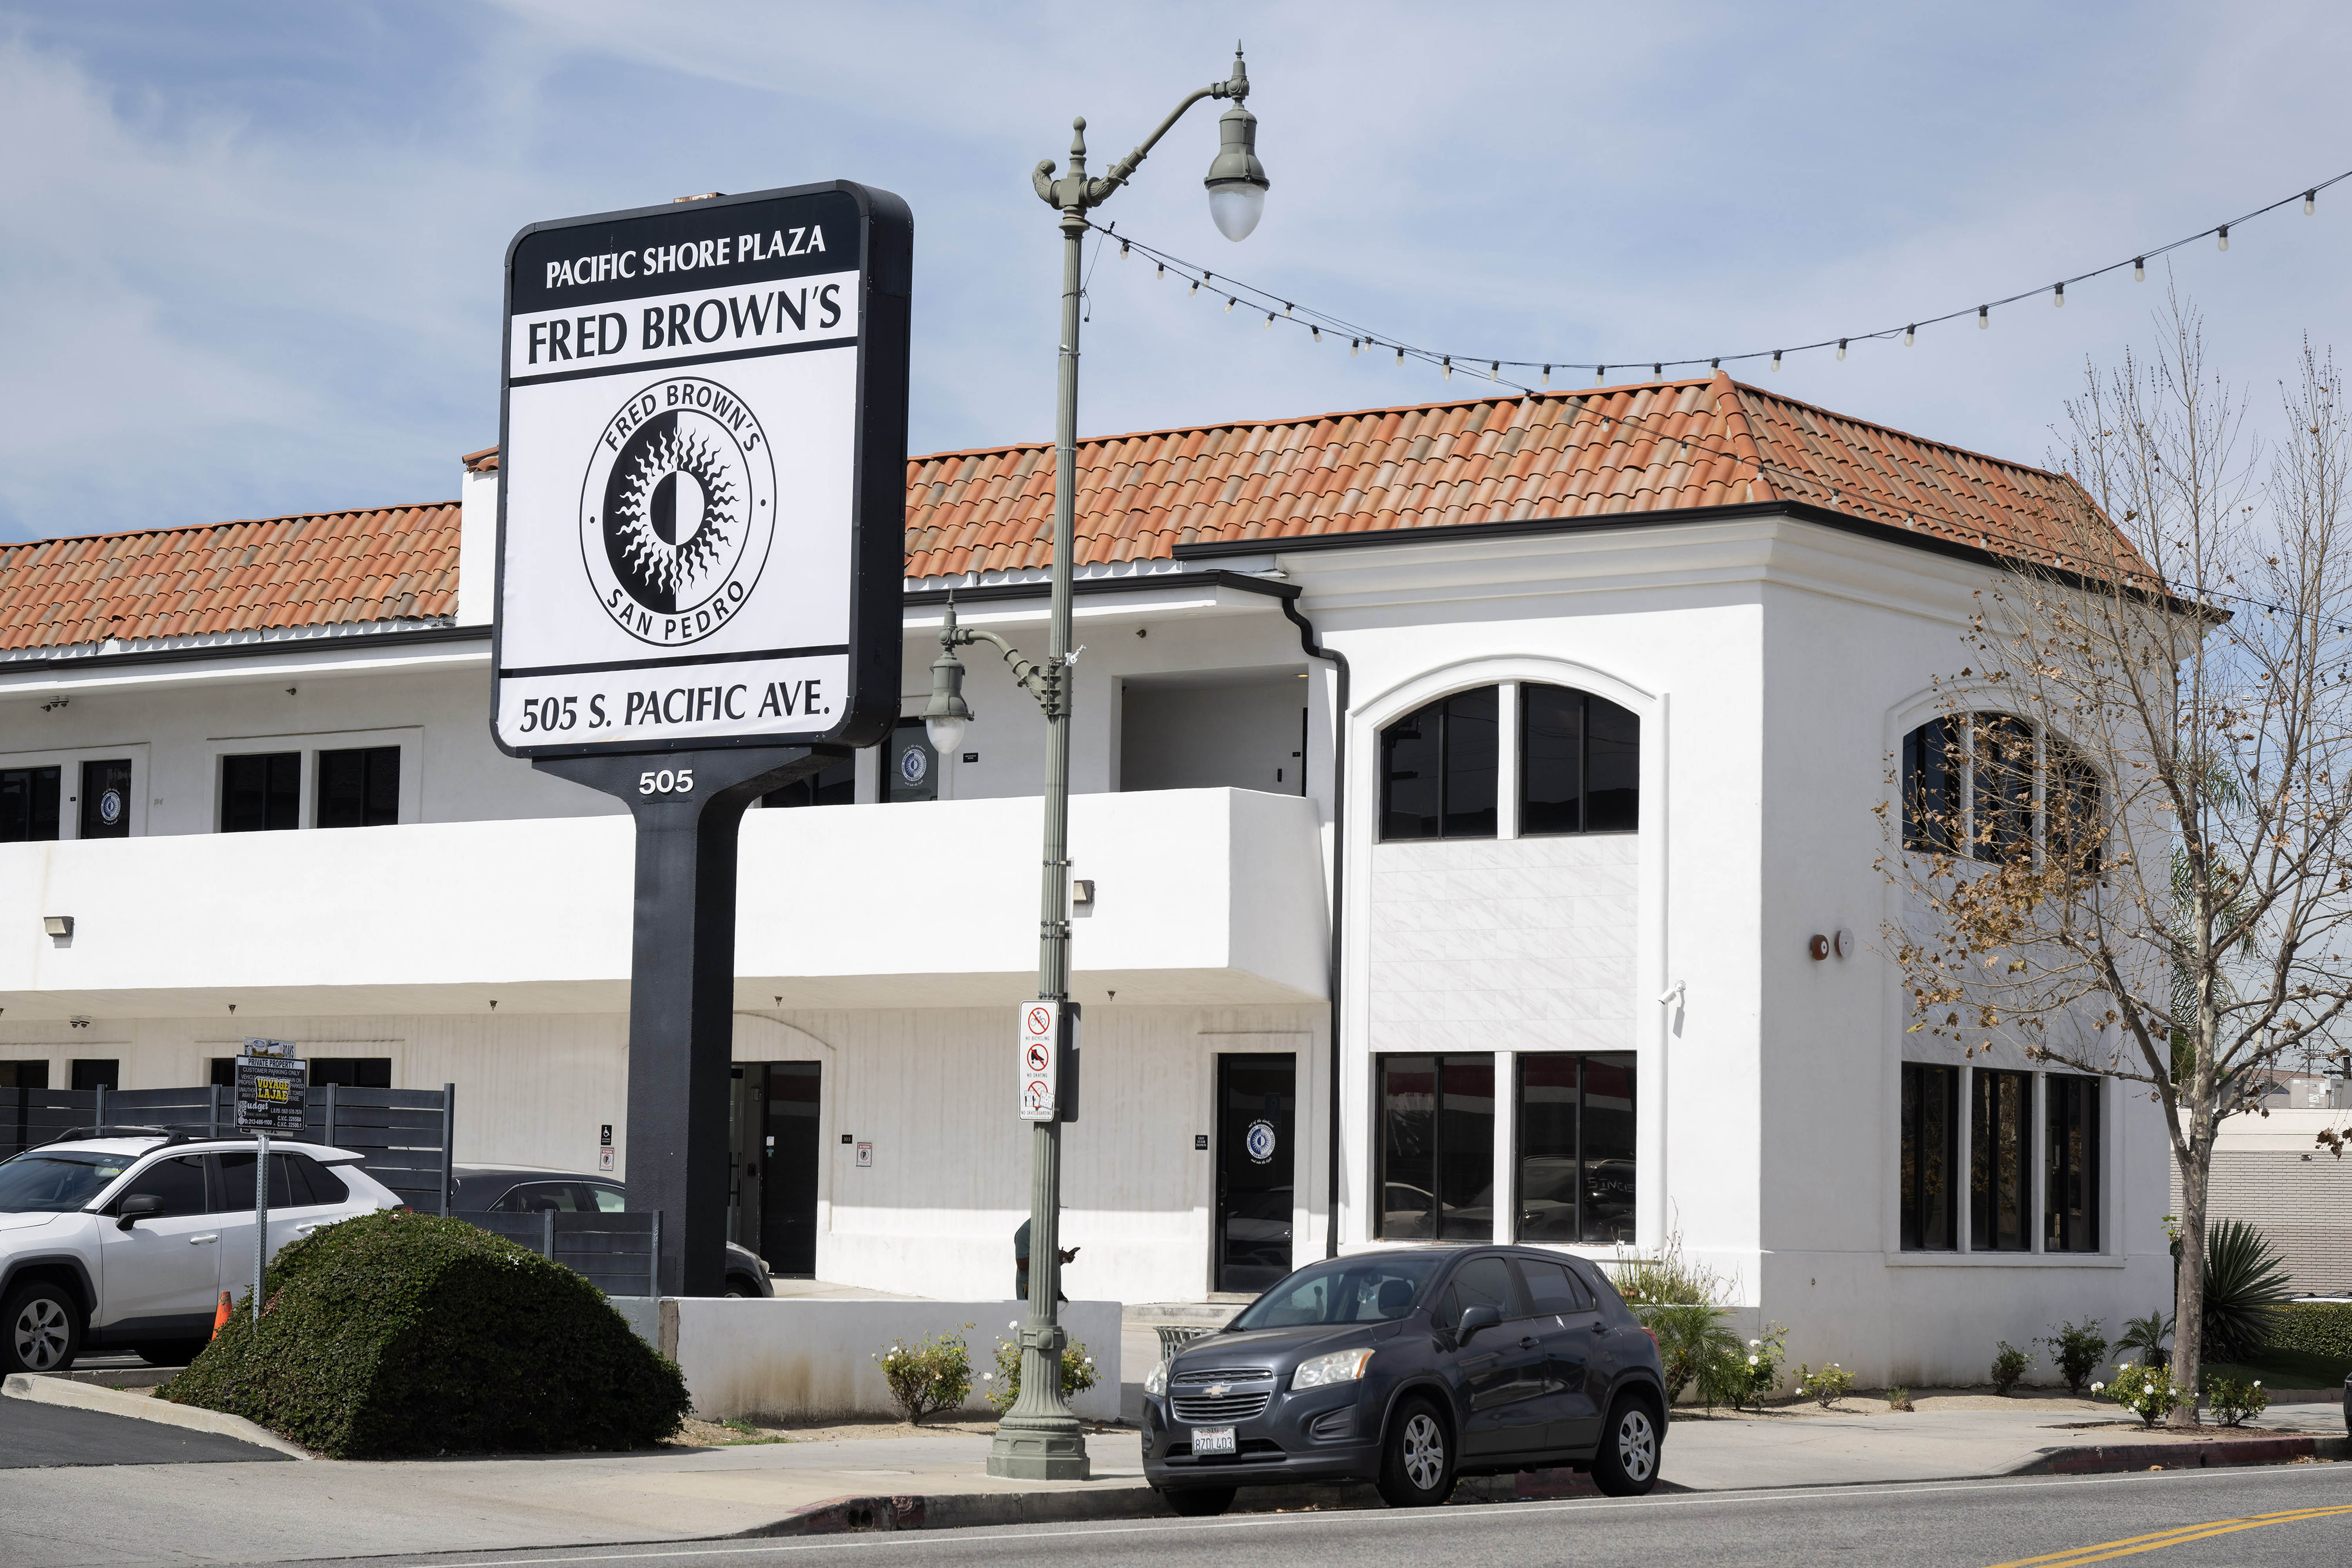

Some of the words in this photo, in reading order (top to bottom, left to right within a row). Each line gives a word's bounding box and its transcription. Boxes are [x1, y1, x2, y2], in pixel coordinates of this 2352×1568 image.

[546, 250, 636, 289] PACIFIC
[643, 237, 730, 276] SHORE
[738, 225, 826, 263] PLAZA
[528, 312, 627, 365] FRED
[642, 284, 841, 350] BROWN'S
[605, 394, 656, 452] FRED
[667, 384, 760, 452] BROWN'S
[607, 589, 653, 636] SAN
[665, 581, 743, 640] PEDRO
[519, 696, 577, 732] 505
[588, 694, 611, 728] S.
[624, 684, 747, 726] PACIFIC
[757, 679, 829, 718] AVE.
[639, 769, 693, 795] 505
[248, 1058, 268, 1067] PRIVATE
[269, 1060, 295, 1068] PROPERTY
[257, 1078, 290, 1090] VOYAGE
[247, 1102, 269, 1112] udget
